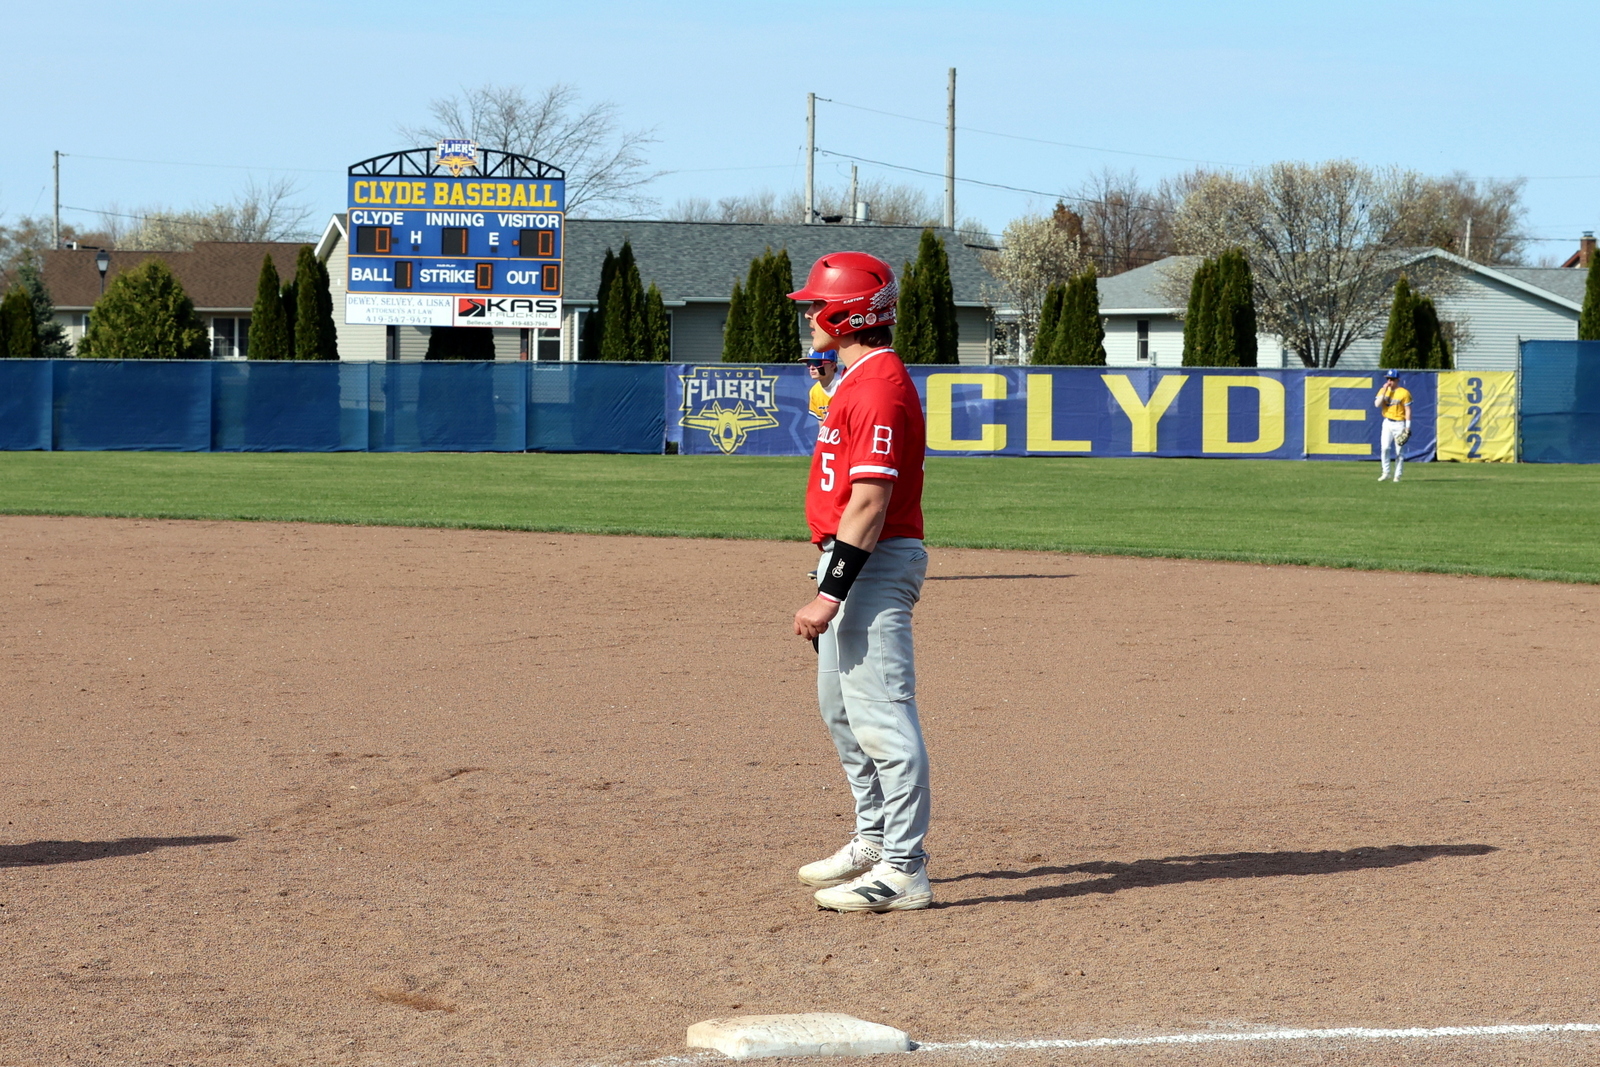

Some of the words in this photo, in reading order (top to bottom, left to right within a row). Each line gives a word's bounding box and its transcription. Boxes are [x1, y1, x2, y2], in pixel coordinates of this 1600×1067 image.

[438, 143, 475, 157] FLIERS
[354, 181, 426, 204] CLYDE
[433, 182, 557, 207] BASEBALL
[351, 211, 404, 225] CLYDE
[426, 212, 485, 227] INNING
[498, 213, 559, 228] VISITOR
[410, 230, 422, 244] H
[488, 232, 499, 245] E
[351, 267, 392, 282] BALL
[419, 268, 475, 284] STRIKE
[506, 270, 539, 285] OUT
[426, 299, 451, 307] LISKA
[487, 299, 557, 313] KAS
[686, 379, 771, 407] FLIERS
[925, 373, 1373, 455] CLYDE
[871, 424, 893, 455] B
[820, 452, 835, 492] 5
